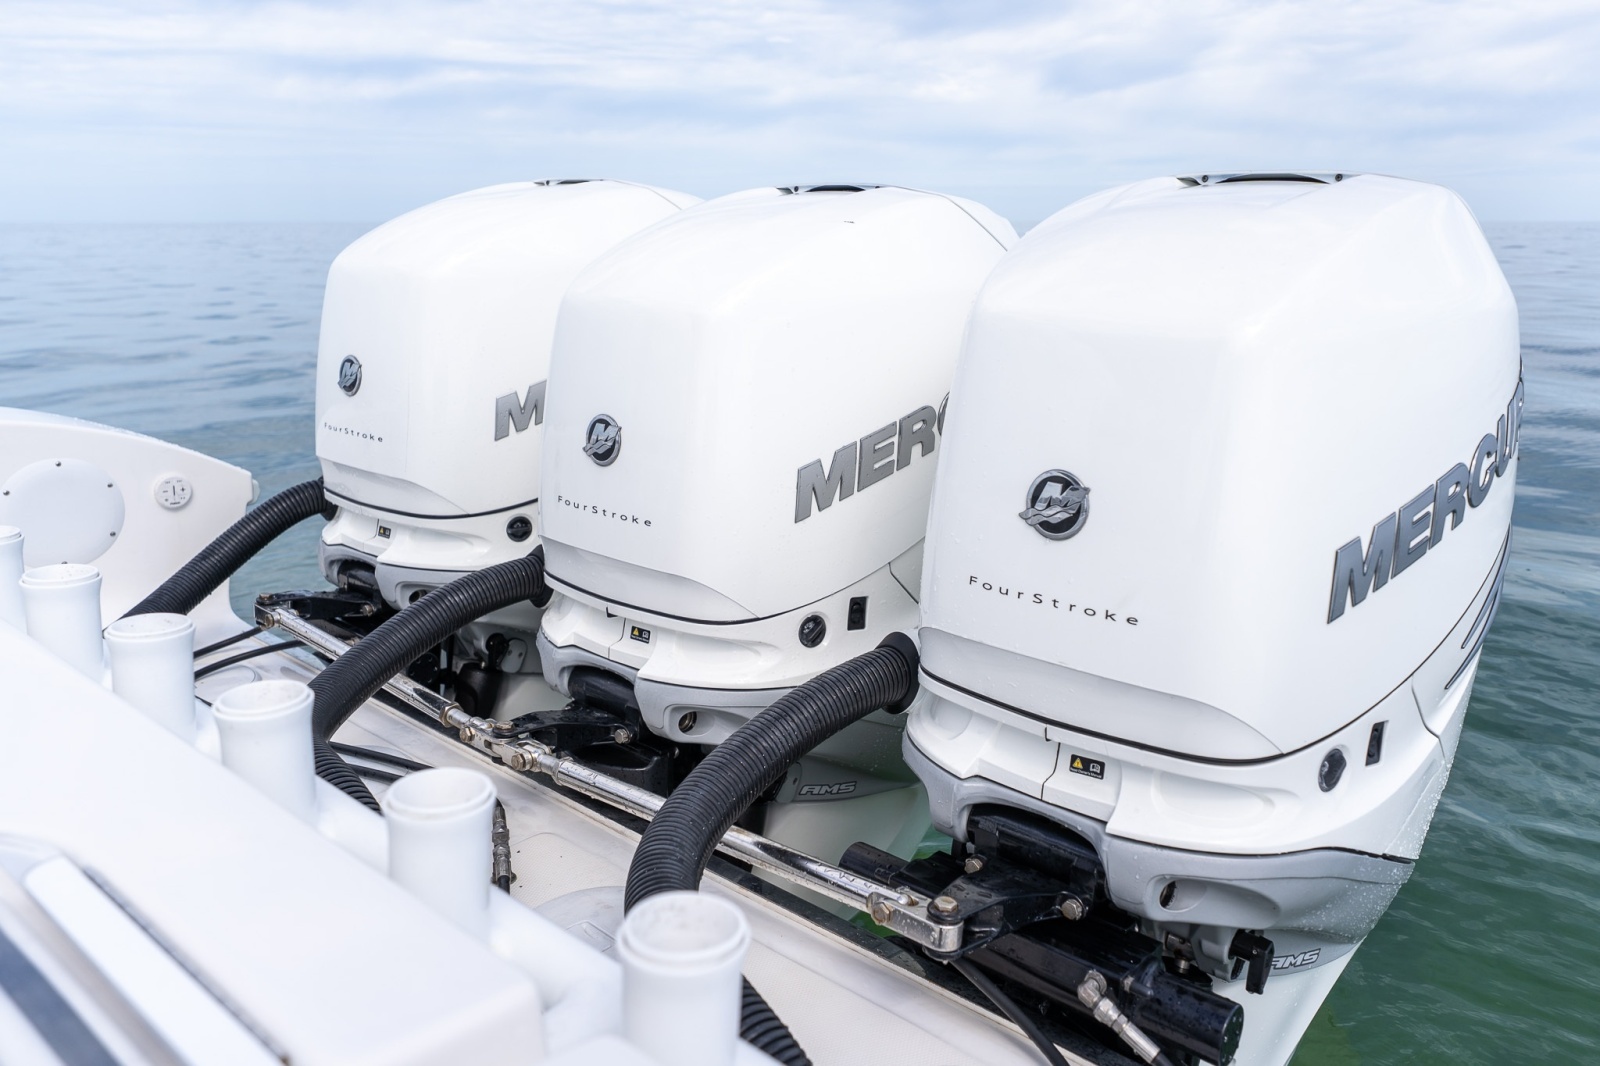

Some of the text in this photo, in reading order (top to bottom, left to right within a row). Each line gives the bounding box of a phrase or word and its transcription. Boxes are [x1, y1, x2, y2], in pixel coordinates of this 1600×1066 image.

[324, 421, 383, 443] FourStroke
[794, 391, 951, 524] MER
[1327, 352, 1524, 624] MERCUR
[557, 495, 652, 527] FourStroke
[968, 575, 1139, 626] FourStroke
[798, 781, 858, 796] AMS
